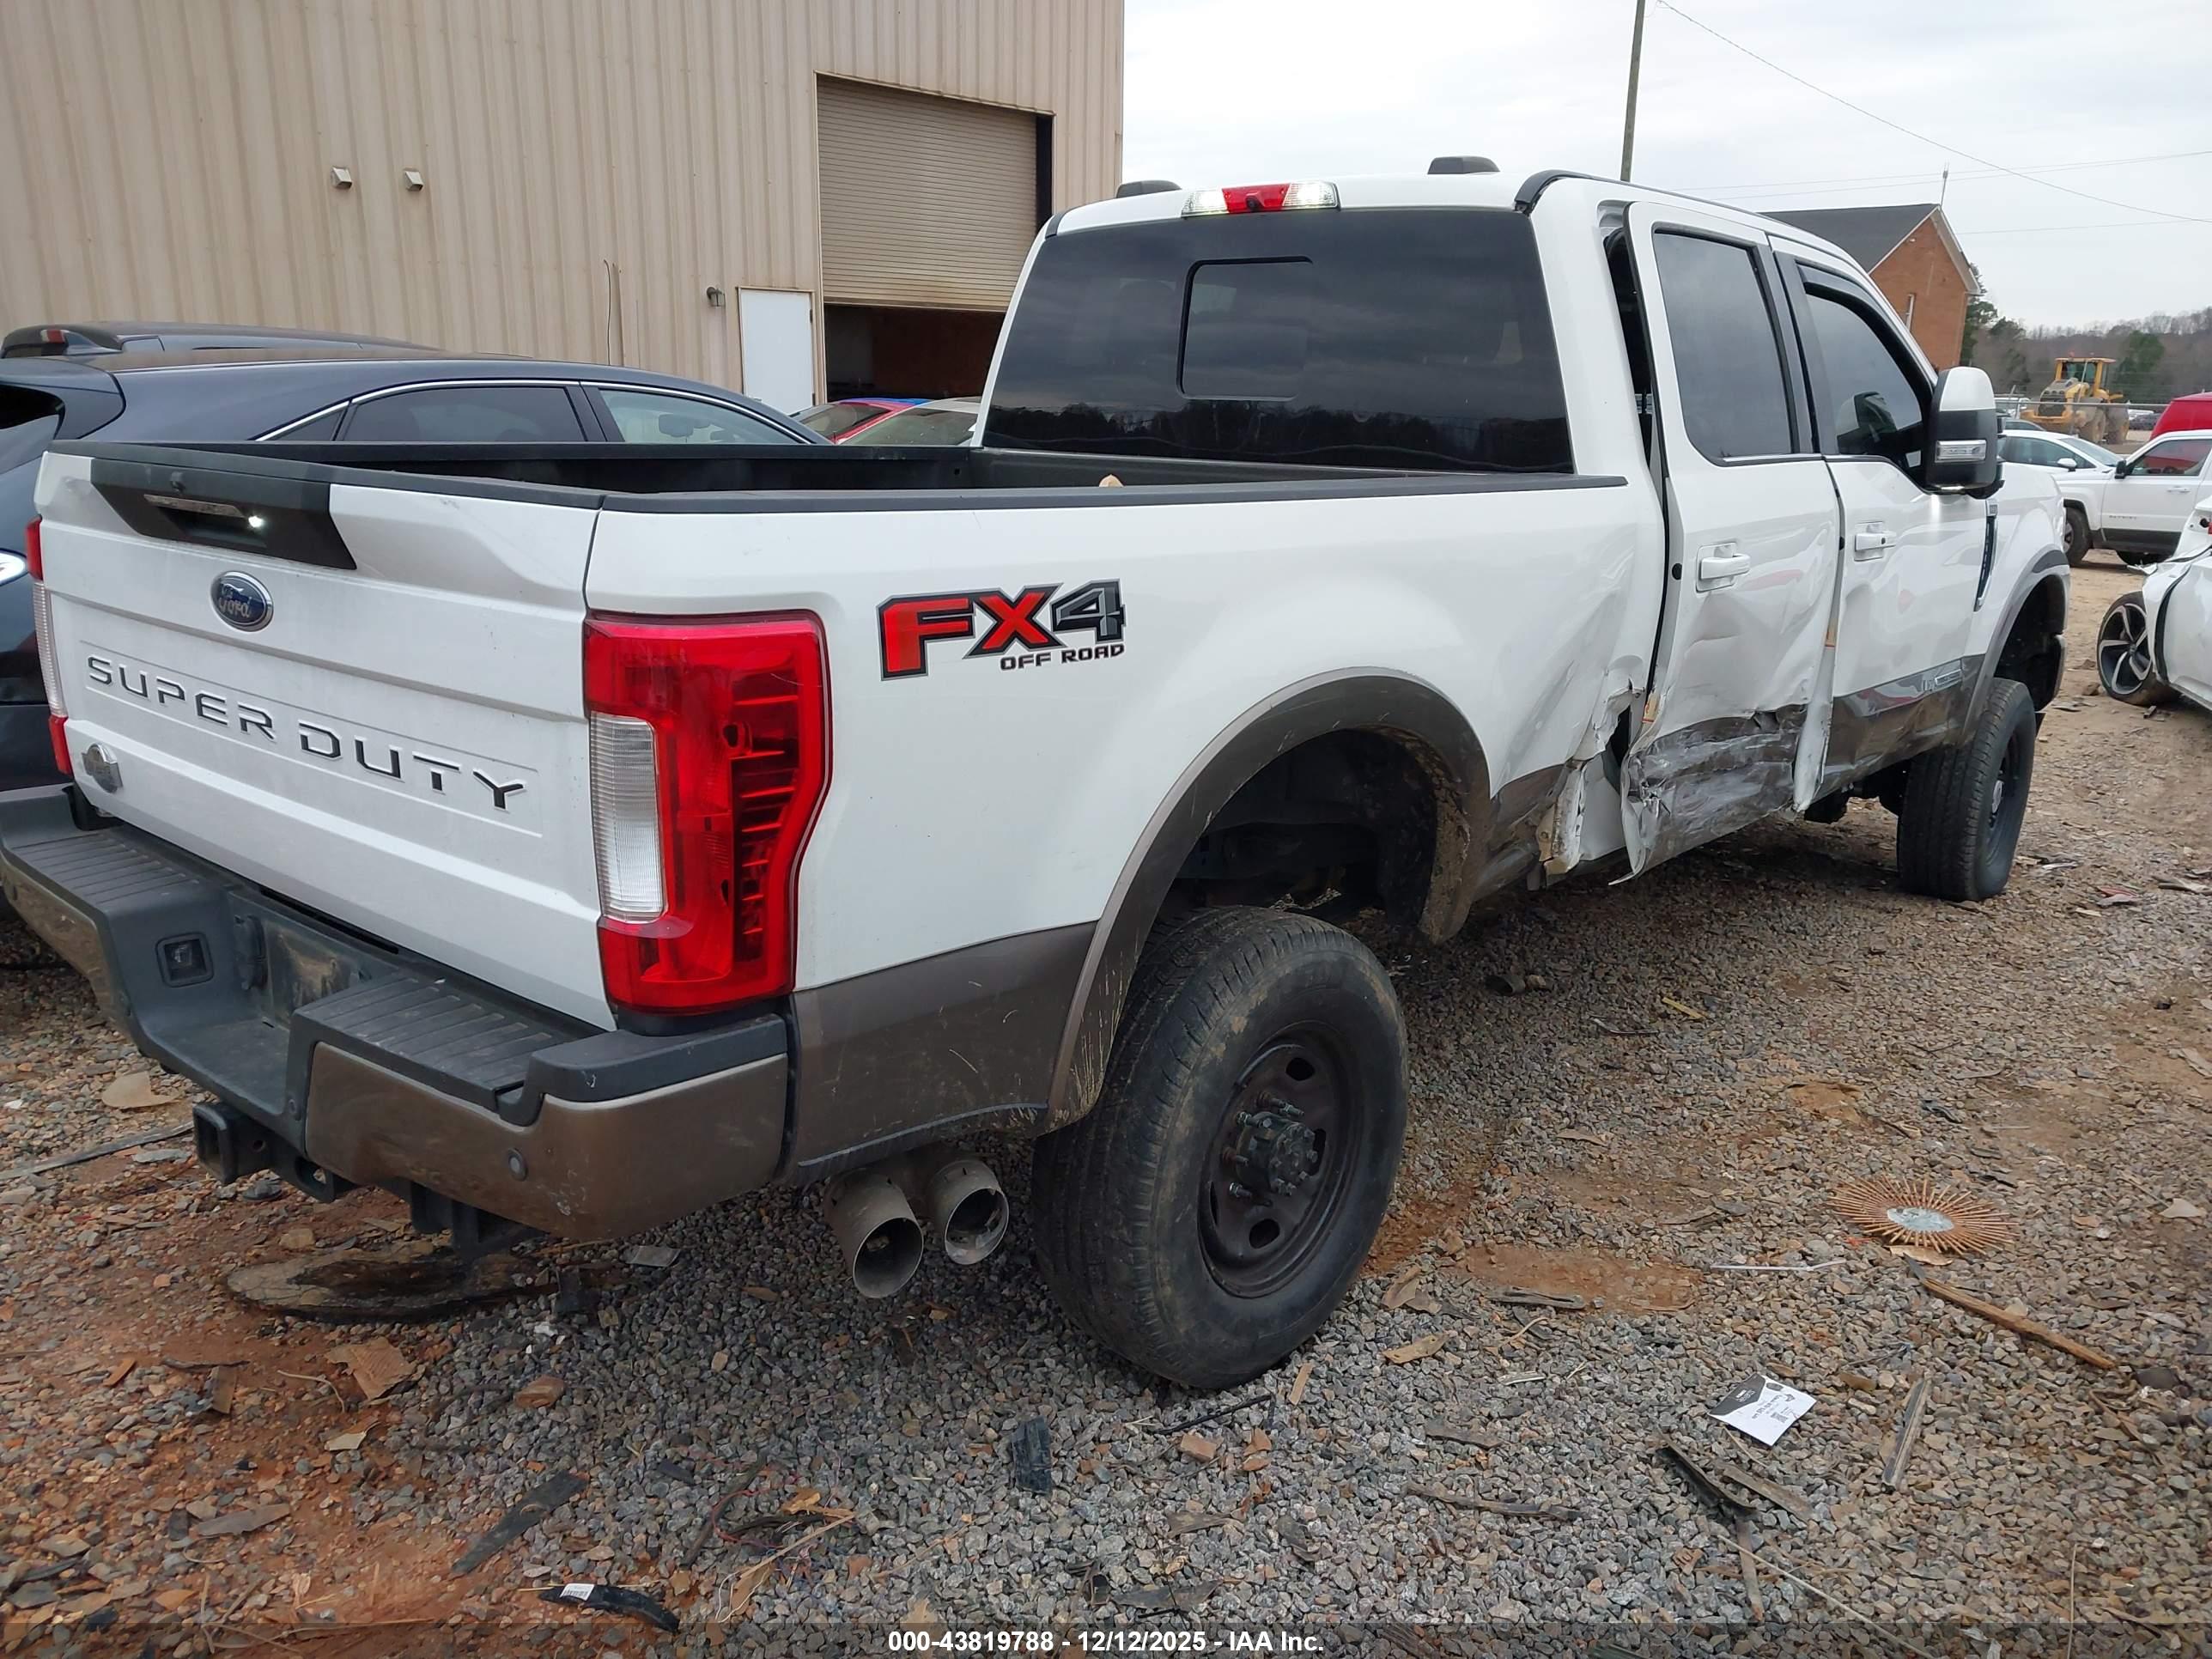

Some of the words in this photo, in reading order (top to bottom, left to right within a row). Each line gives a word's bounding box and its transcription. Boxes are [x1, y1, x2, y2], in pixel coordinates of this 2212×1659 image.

[876, 578, 1127, 681] FX4
[1000, 653, 1052, 672] OFF
[1061, 643, 1125, 664] ROAD
[87, 655, 276, 742] SUPER
[298, 720, 526, 811] DUTY
